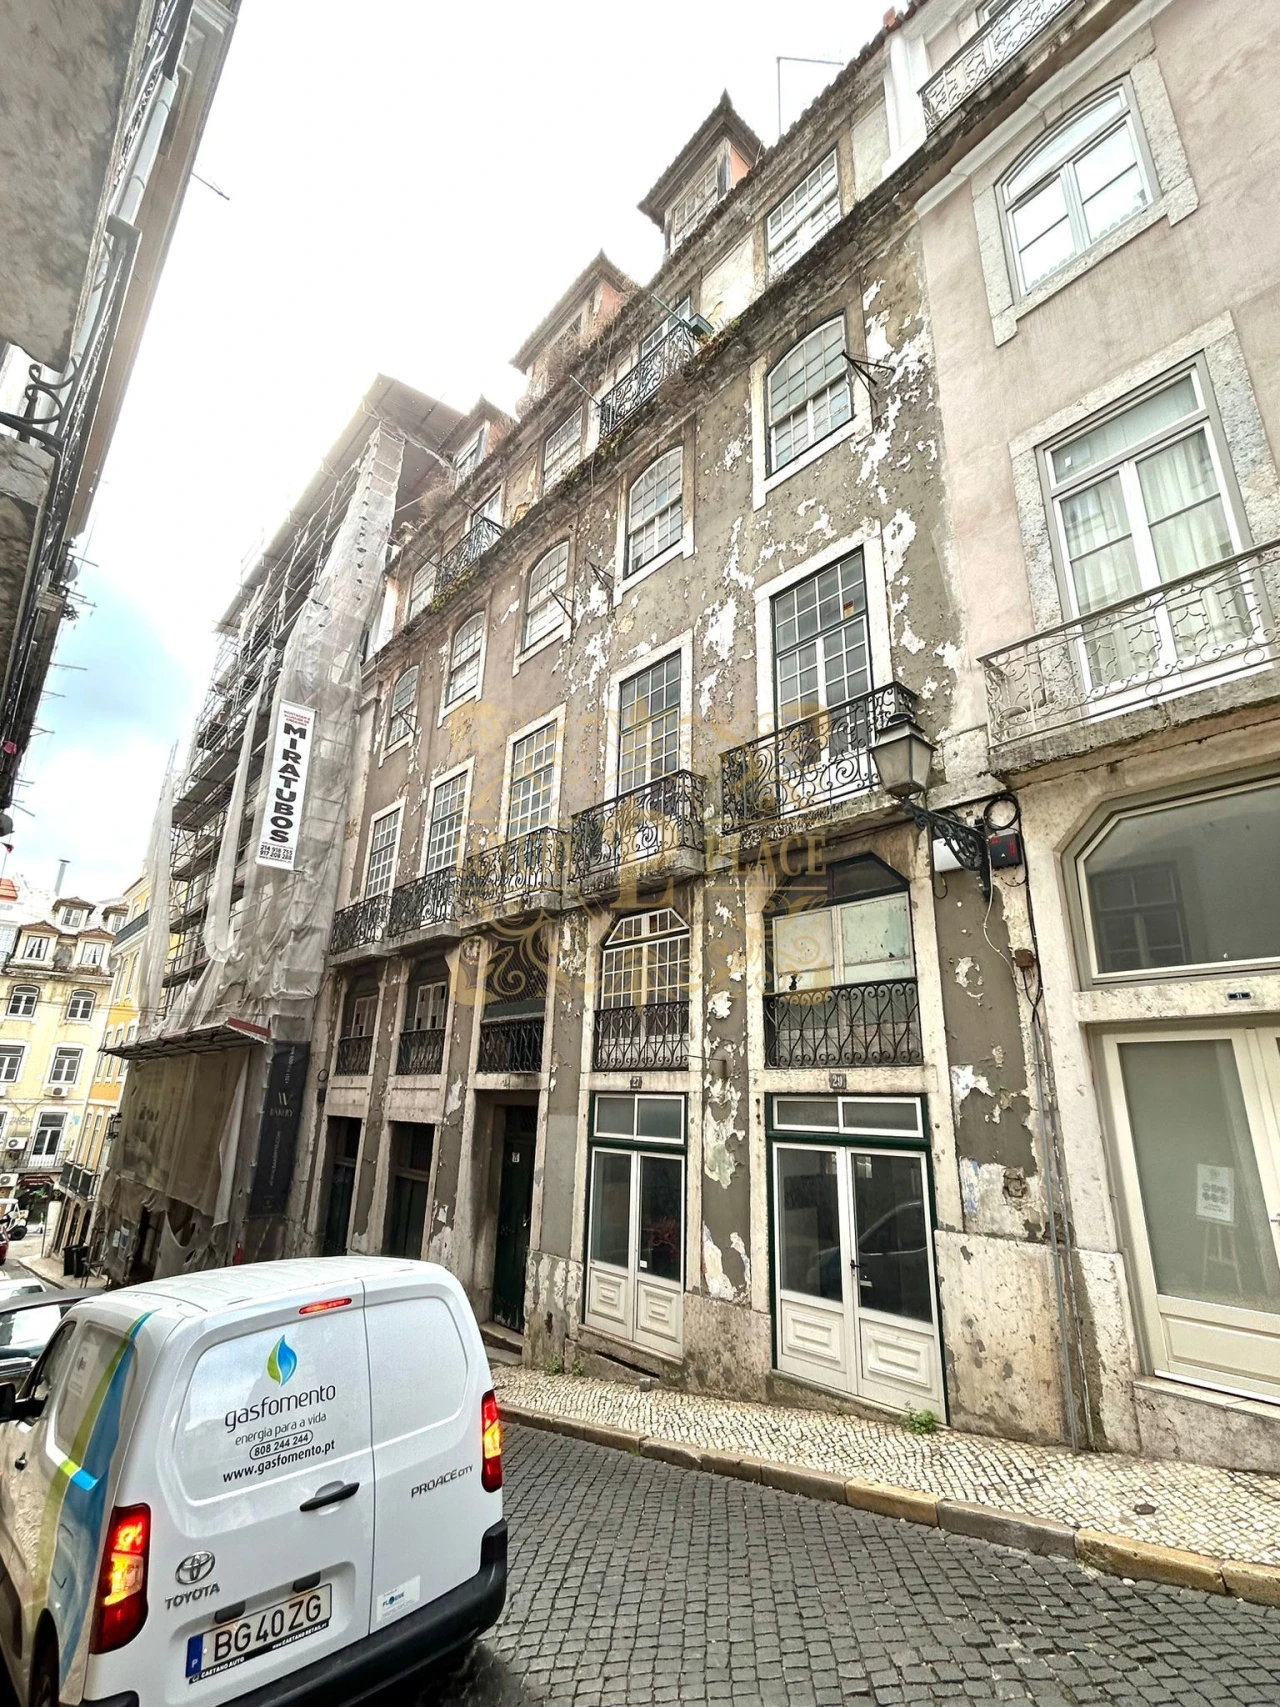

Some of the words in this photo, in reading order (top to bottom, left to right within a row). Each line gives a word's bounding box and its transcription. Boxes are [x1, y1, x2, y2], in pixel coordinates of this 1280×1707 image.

[270, 722, 307, 843] MIRATUBOS
[632, 1076, 640, 1087] 27
[832, 1074, 843, 1088] 29
[224, 1385, 336, 1433] gasfomento
[235, 1427, 272, 1446] energia
[274, 1421, 297, 1438] para
[300, 1420, 306, 1428] a
[307, 1412, 326, 1425] vida
[254, 1444, 272, 1457] 808
[274, 1438, 290, 1452] 244
[292, 1433, 309, 1446] 244
[222, 1439, 336, 1482] www.gasfomento.pt
[410, 1468, 458, 1499] PROACE
[458, 1464, 474, 1478] CITY
[164, 1582, 220, 1610] TOYOTA
[191, 1658, 198, 1668] P
[200, 1661, 228, 1679] CAETANO
[228, 1656, 244, 1668] AUTO
